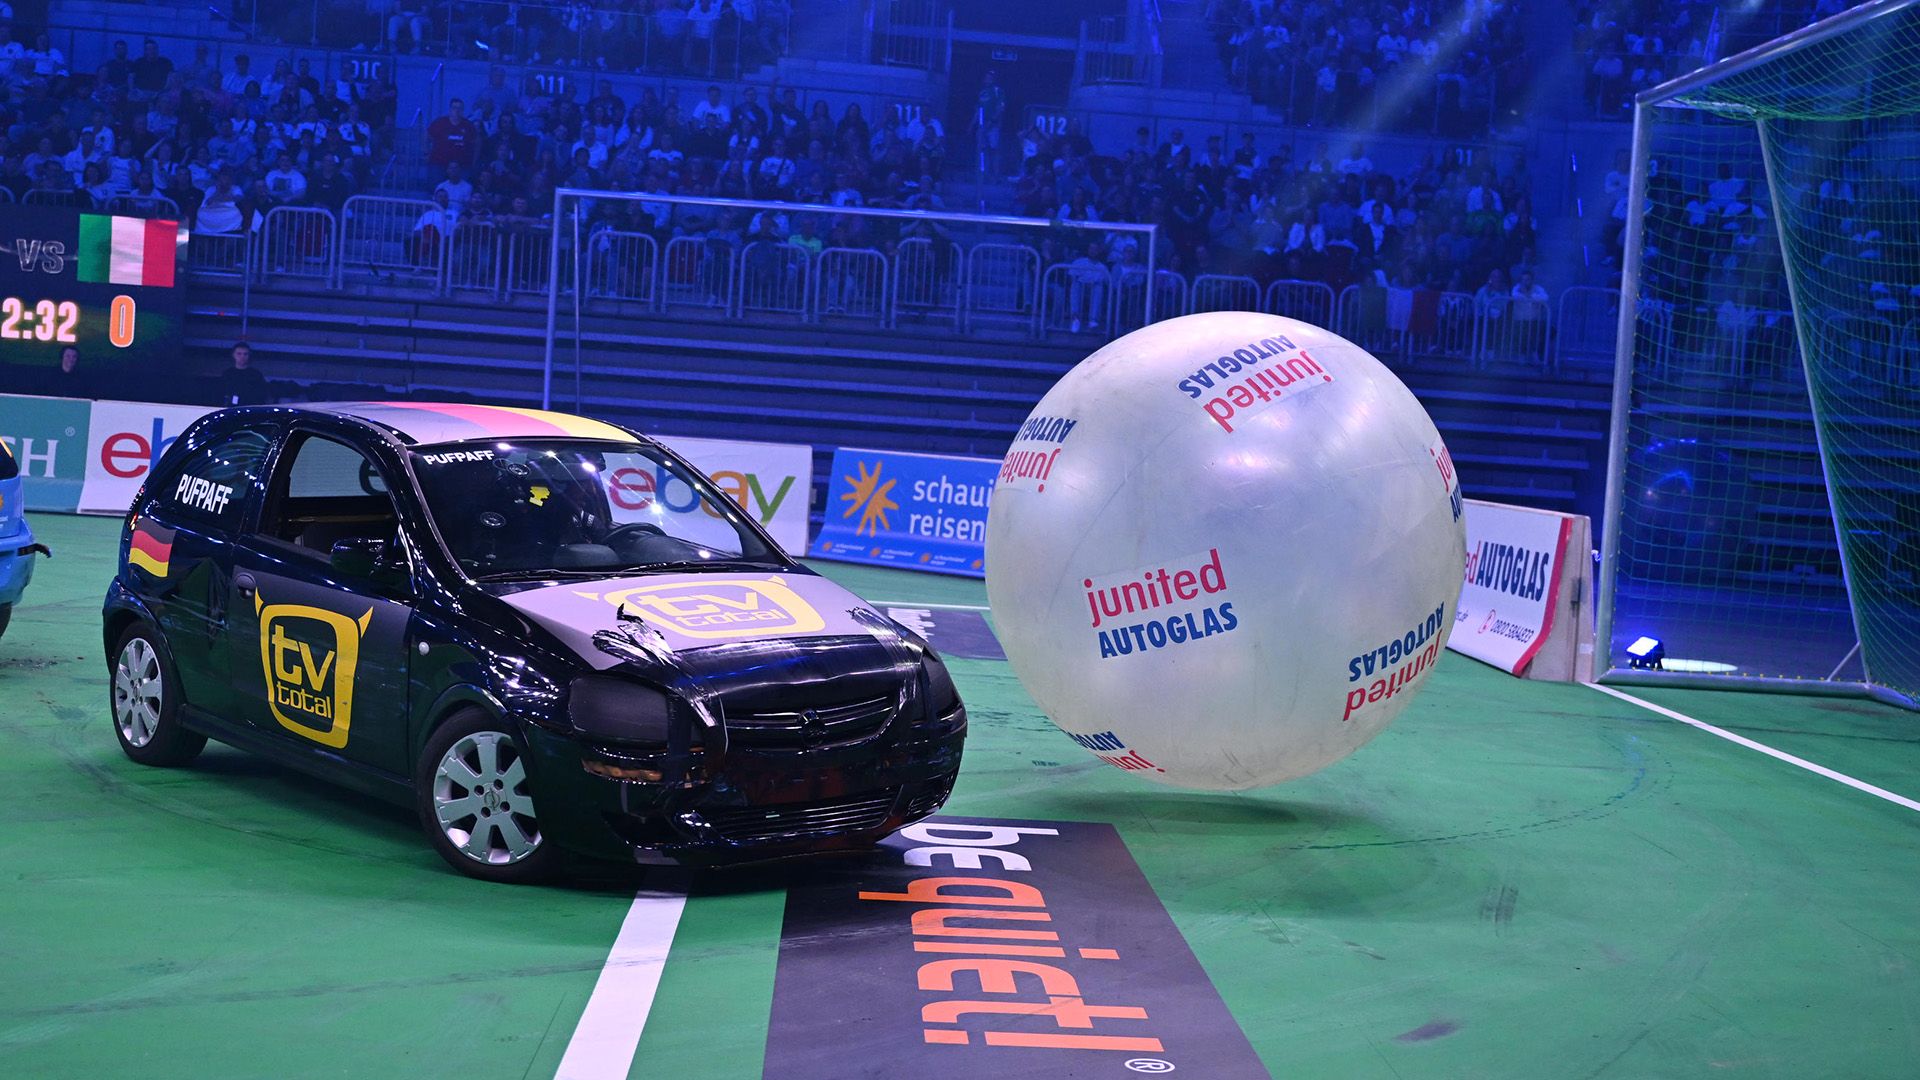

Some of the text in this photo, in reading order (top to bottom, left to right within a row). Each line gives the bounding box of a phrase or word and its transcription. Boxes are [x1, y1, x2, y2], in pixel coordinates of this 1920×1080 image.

[16, 238, 65, 274] VS
[109, 294, 136, 348] 0
[1178, 334, 1298, 400] AUTOGLAS
[1202, 350, 1333, 434] junited
[422, 450, 495, 465] PUFPAFF
[998, 448, 1062, 493] junite
[174, 473, 234, 514] PUFPAFF
[609, 465, 796, 528] ebay
[912, 475, 994, 508] schaui
[908, 508, 985, 541] reisen
[1084, 548, 1227, 628] junited
[1475, 541, 1550, 602] AUTOGLAS
[636, 592, 759, 617] tv
[675, 609, 788, 627] total
[1098, 602, 1238, 659] AUTOGLAS
[271, 624, 336, 692] tv
[1348, 601, 1444, 682] AUTOGLAS
[276, 681, 332, 718] total
[1342, 628, 1443, 722] junited
[900, 822, 1060, 872] be
